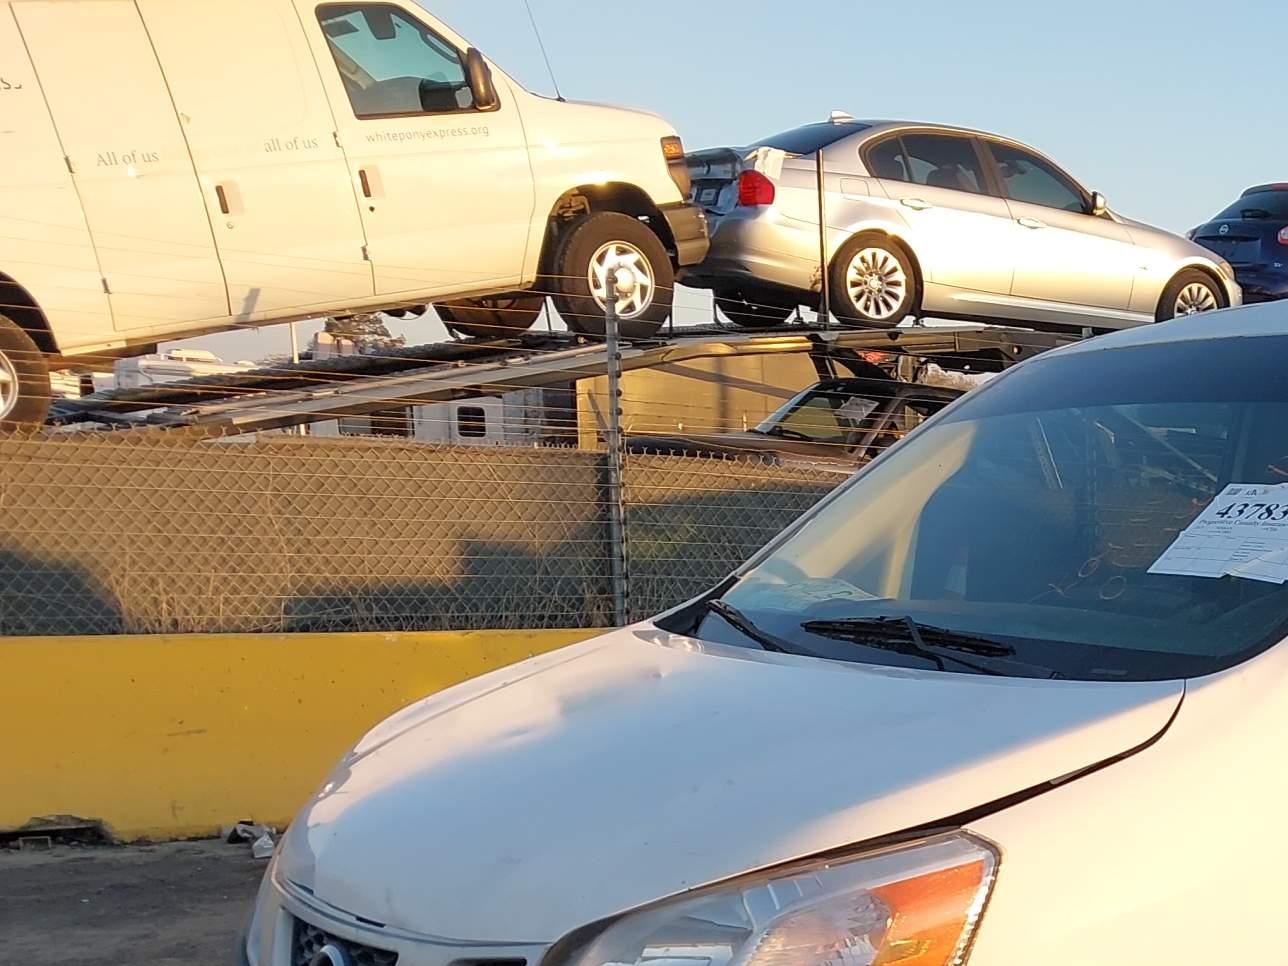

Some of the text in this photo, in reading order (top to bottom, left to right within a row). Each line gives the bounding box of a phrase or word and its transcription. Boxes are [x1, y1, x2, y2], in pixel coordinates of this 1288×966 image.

[365, 124, 489, 144] whiteponyexpress.org
[264, 136, 319, 153] all of us
[96, 150, 160, 167] All of us
